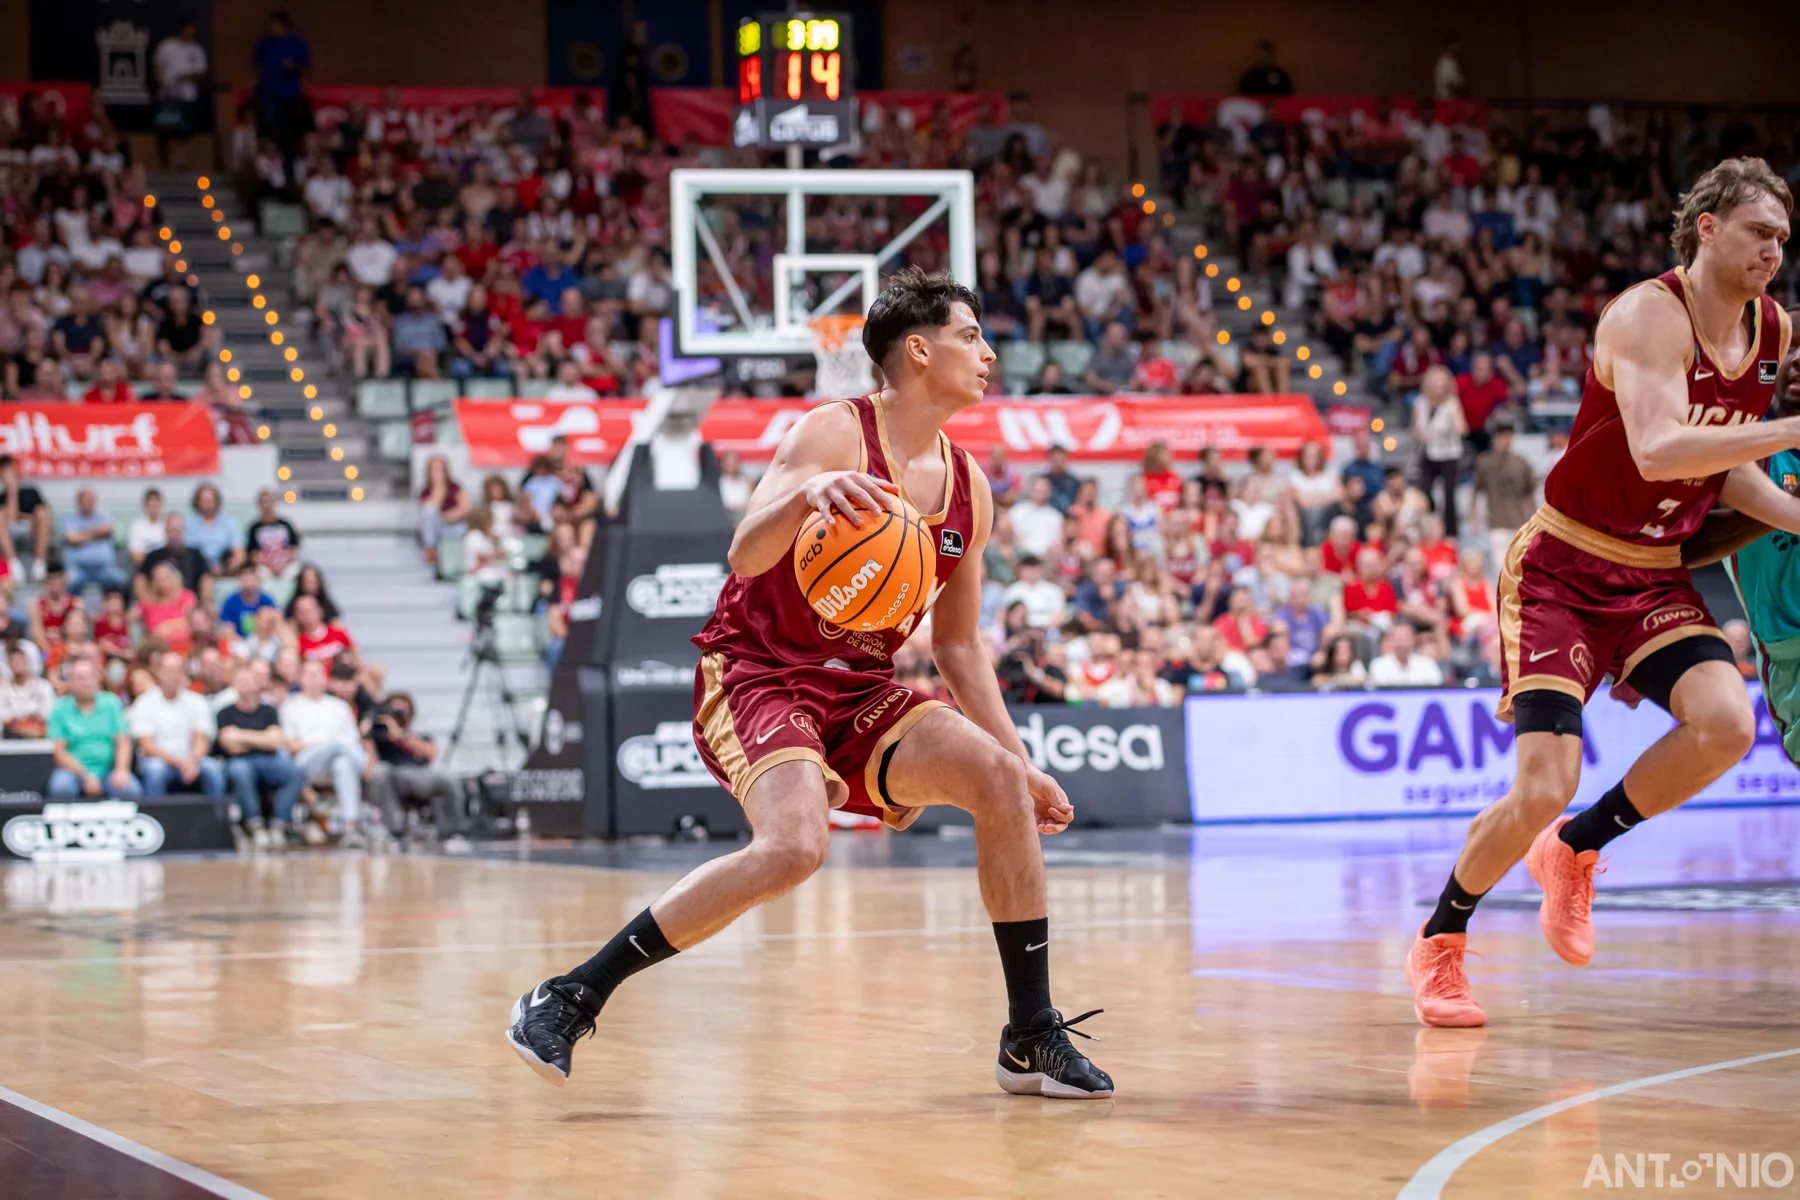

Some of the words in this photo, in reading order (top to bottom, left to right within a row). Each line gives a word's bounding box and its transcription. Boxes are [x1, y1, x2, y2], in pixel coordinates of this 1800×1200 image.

[787, 52, 840, 101] 14
[0, 411, 160, 455] alturf
[800, 542, 823, 571] acb
[812, 558, 883, 620] Wilson
[876, 582, 910, 626] endesa
[1651, 608, 1698, 630] Juver
[846, 636, 860, 648] DE
[860, 642, 889, 661] MURCI
[862, 690, 904, 729] Juver
[1017, 712, 1165, 772] desa
